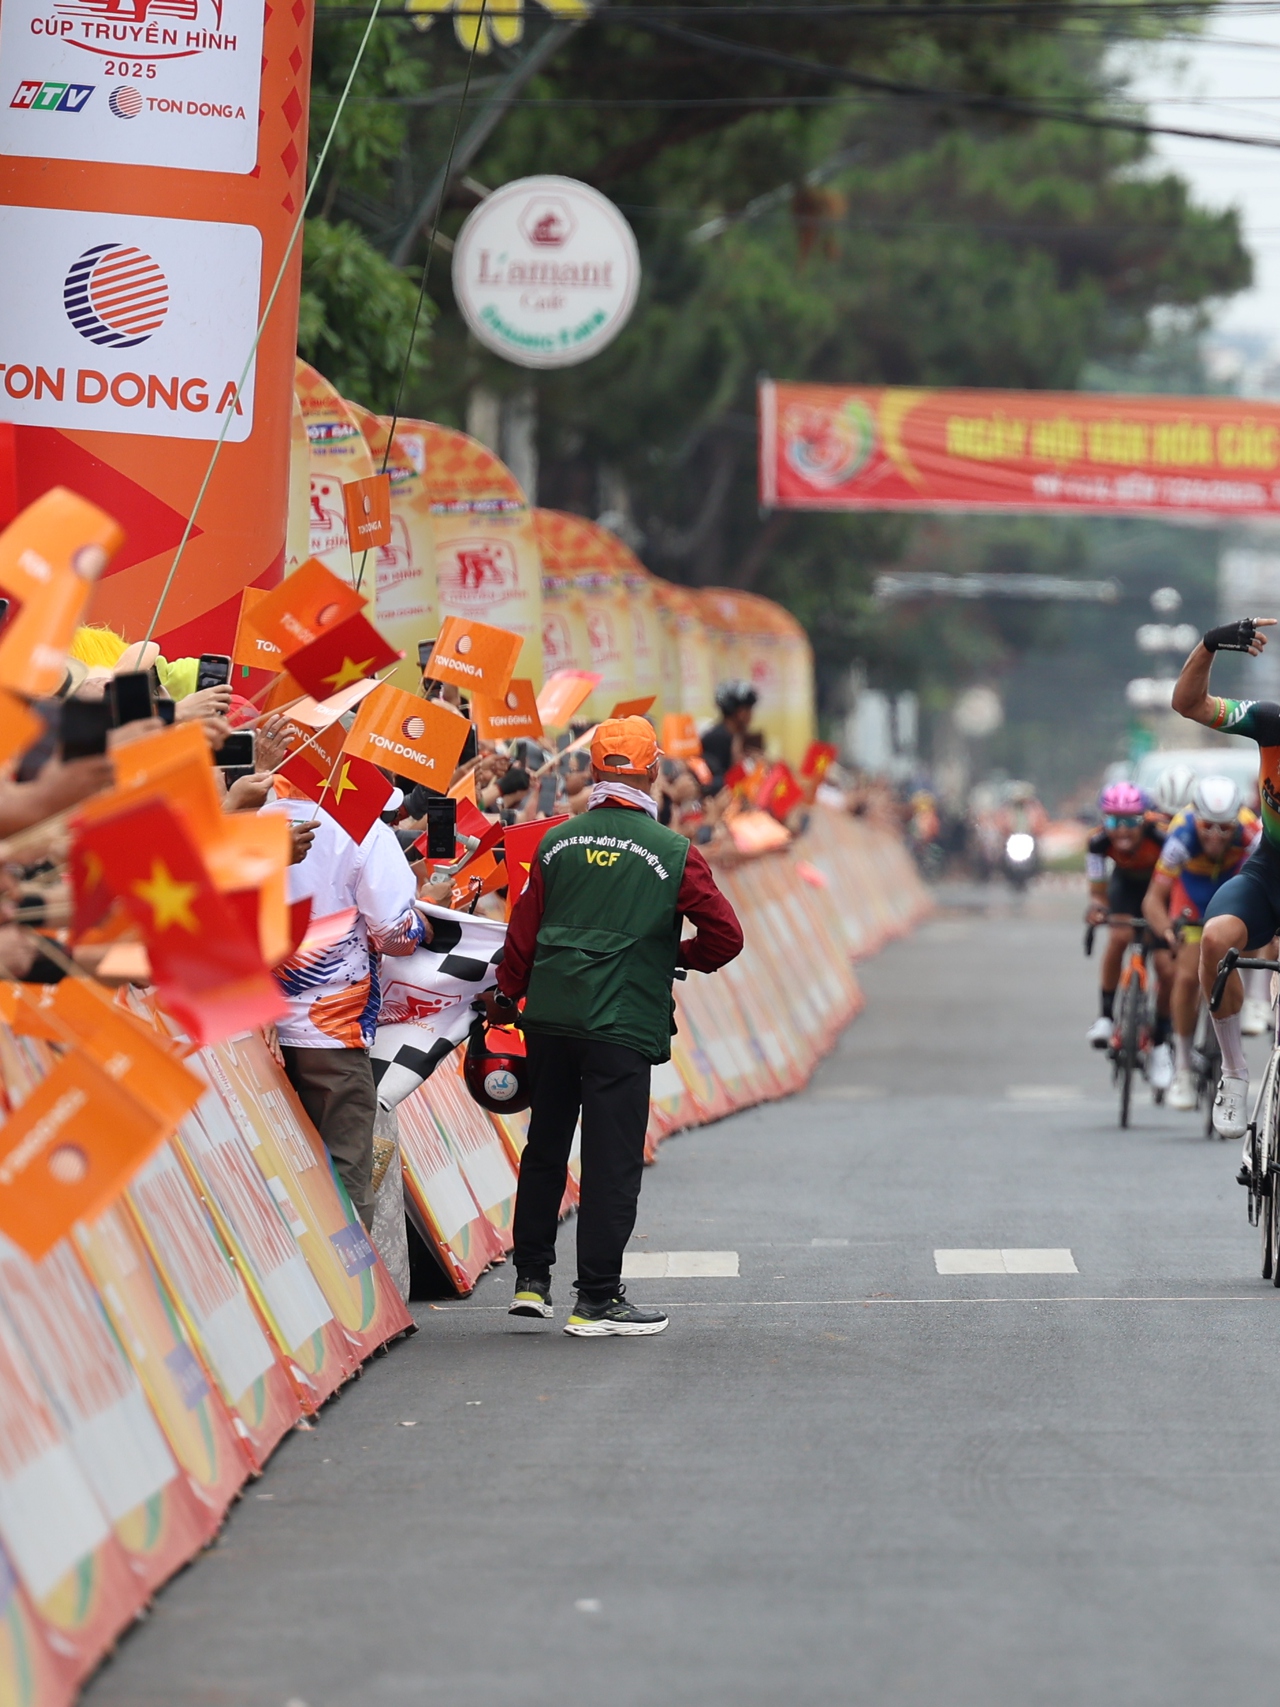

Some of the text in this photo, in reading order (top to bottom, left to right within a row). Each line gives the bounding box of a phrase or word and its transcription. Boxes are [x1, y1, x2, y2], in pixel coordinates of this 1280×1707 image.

[30, 17, 238, 51] CÚP TRUYỀN HÌNH
[104, 60, 157, 79] 2025
[12, 82, 92, 111] HTV
[146, 97, 246, 120] TON DONG A
[0, 362, 244, 415] ON DONG A
[434, 654, 484, 678] TON DONG A
[286, 722, 303, 739] ON
[489, 716, 507, 727] TON
[508, 715, 526, 724] DONG
[369, 732, 435, 769] TON DONG A
[1262, 788, 1274, 808] LE
[569, 836, 578, 845] XE
[629, 843, 648, 857] THAO
[653, 865, 670, 880] NAM
[585, 848, 621, 867] VCF
